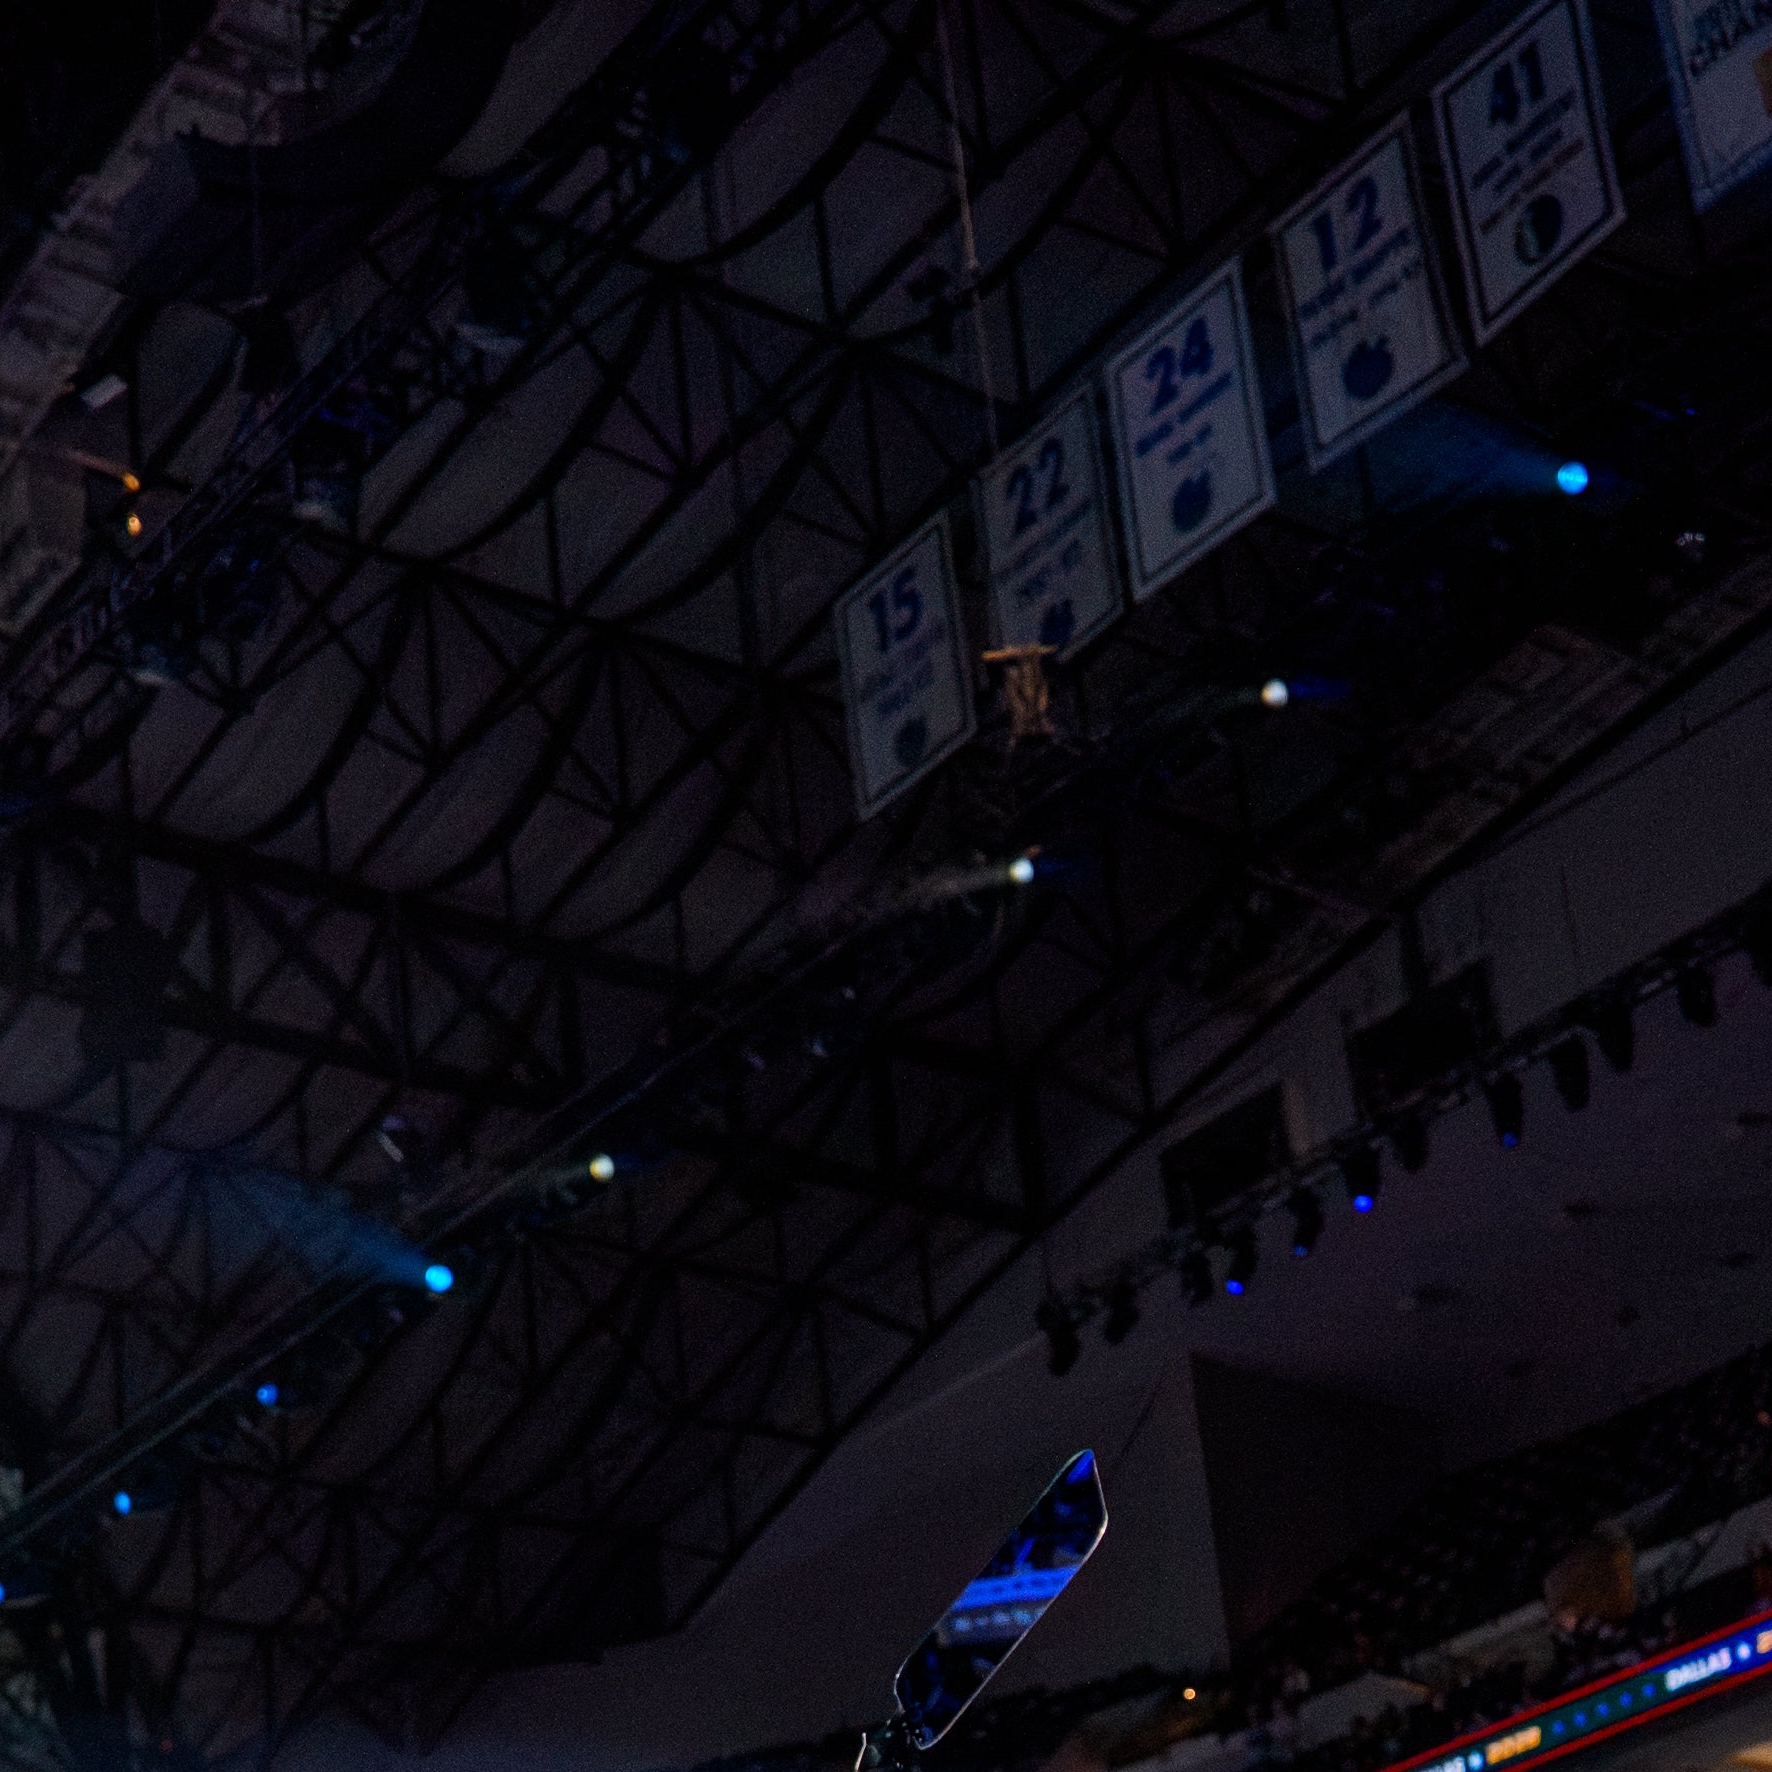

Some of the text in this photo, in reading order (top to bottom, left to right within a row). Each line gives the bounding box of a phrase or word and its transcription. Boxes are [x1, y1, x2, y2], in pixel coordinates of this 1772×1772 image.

[1313, 175, 1380, 272] 12
[1146, 317, 1212, 416] 24
[1006, 438, 1068, 536] 22
[870, 566, 922, 652] 15
[1666, 1648, 1731, 1689] DALLAS
